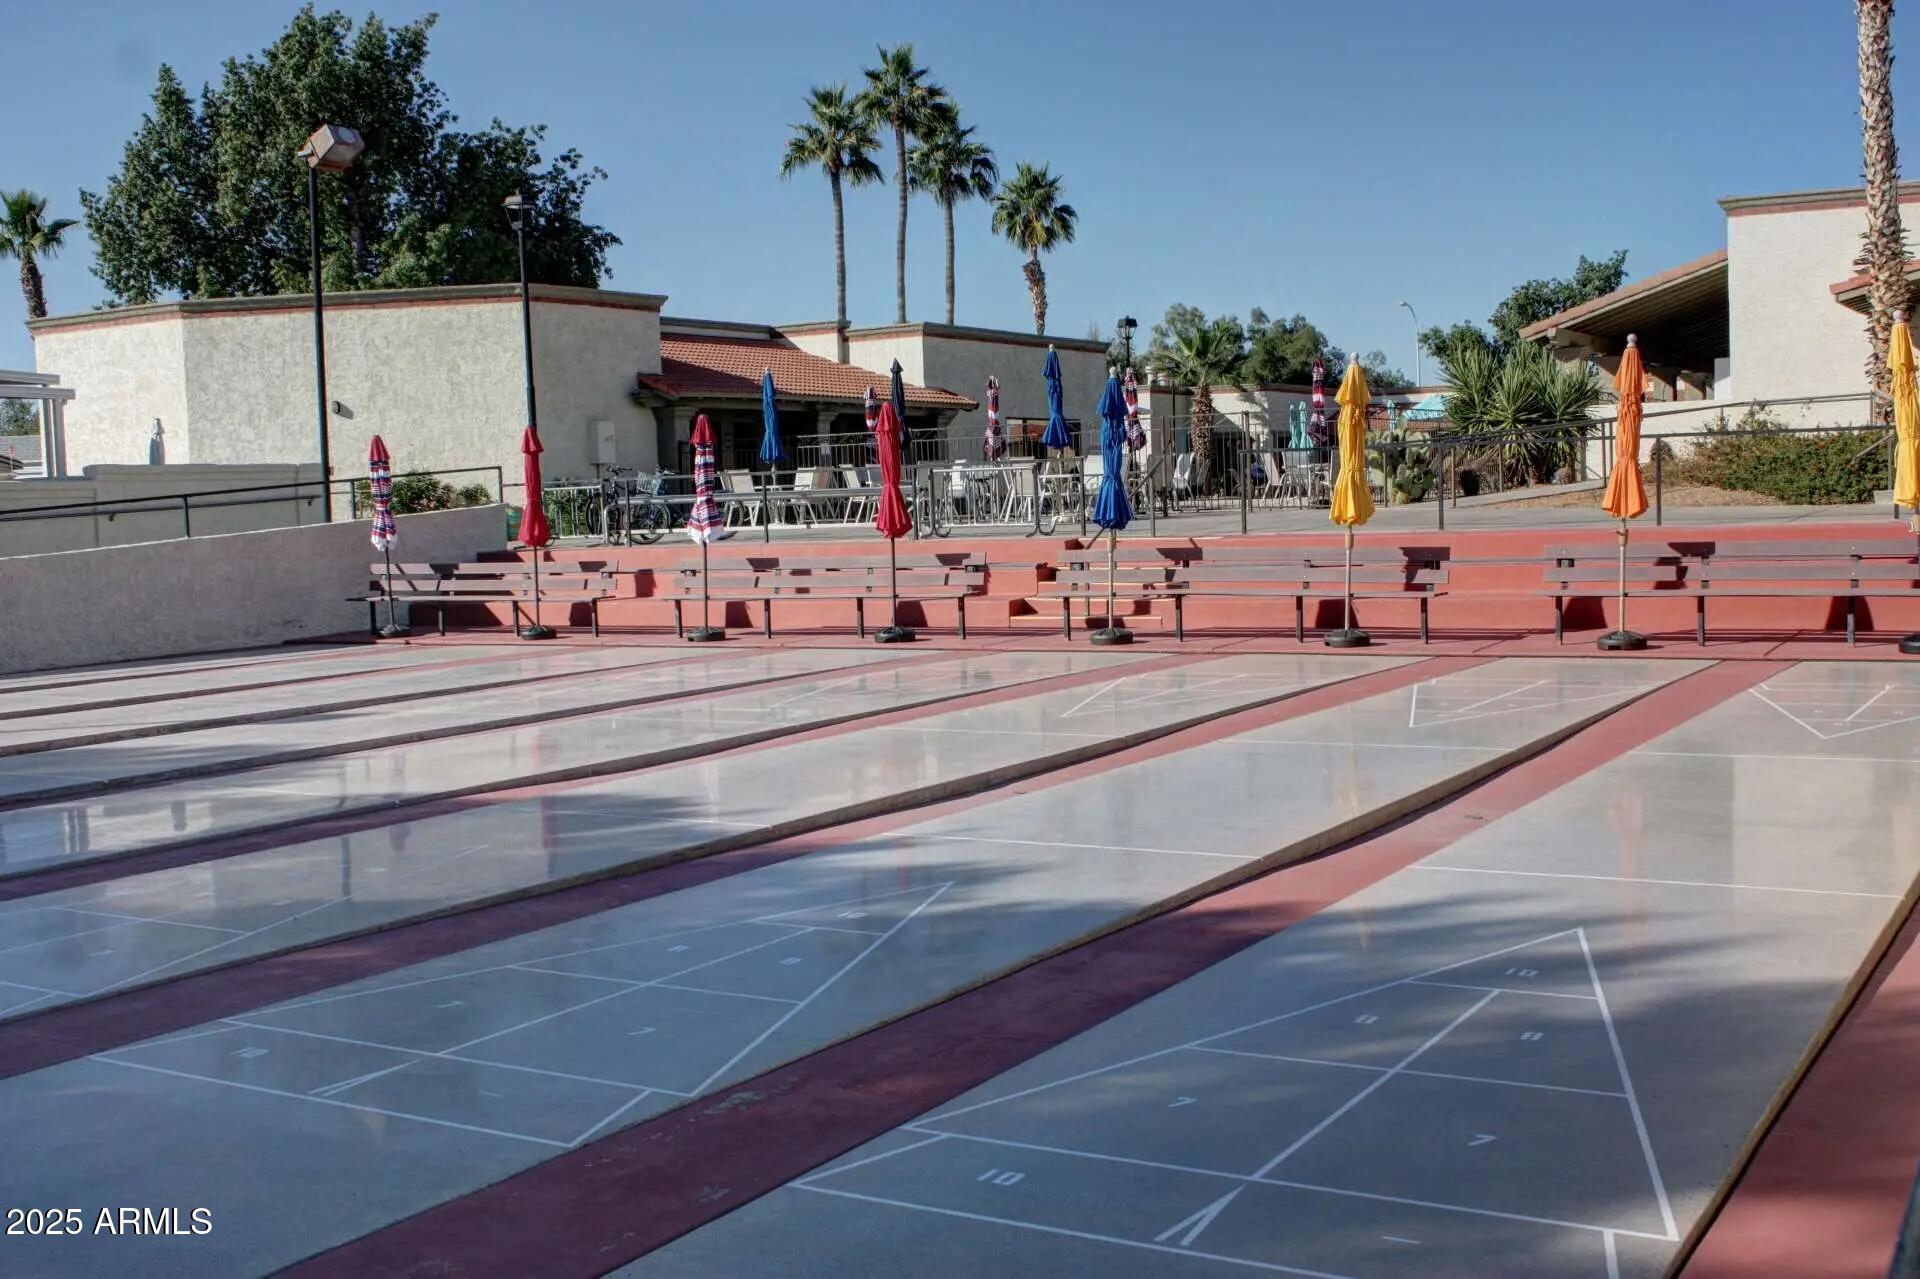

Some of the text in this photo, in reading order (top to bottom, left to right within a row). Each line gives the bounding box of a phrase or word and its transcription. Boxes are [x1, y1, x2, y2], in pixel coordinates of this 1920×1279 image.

[1167, 1096, 1197, 1108] 7
[1466, 1133, 1497, 1146] 7
[976, 1169, 1026, 1186] 10
